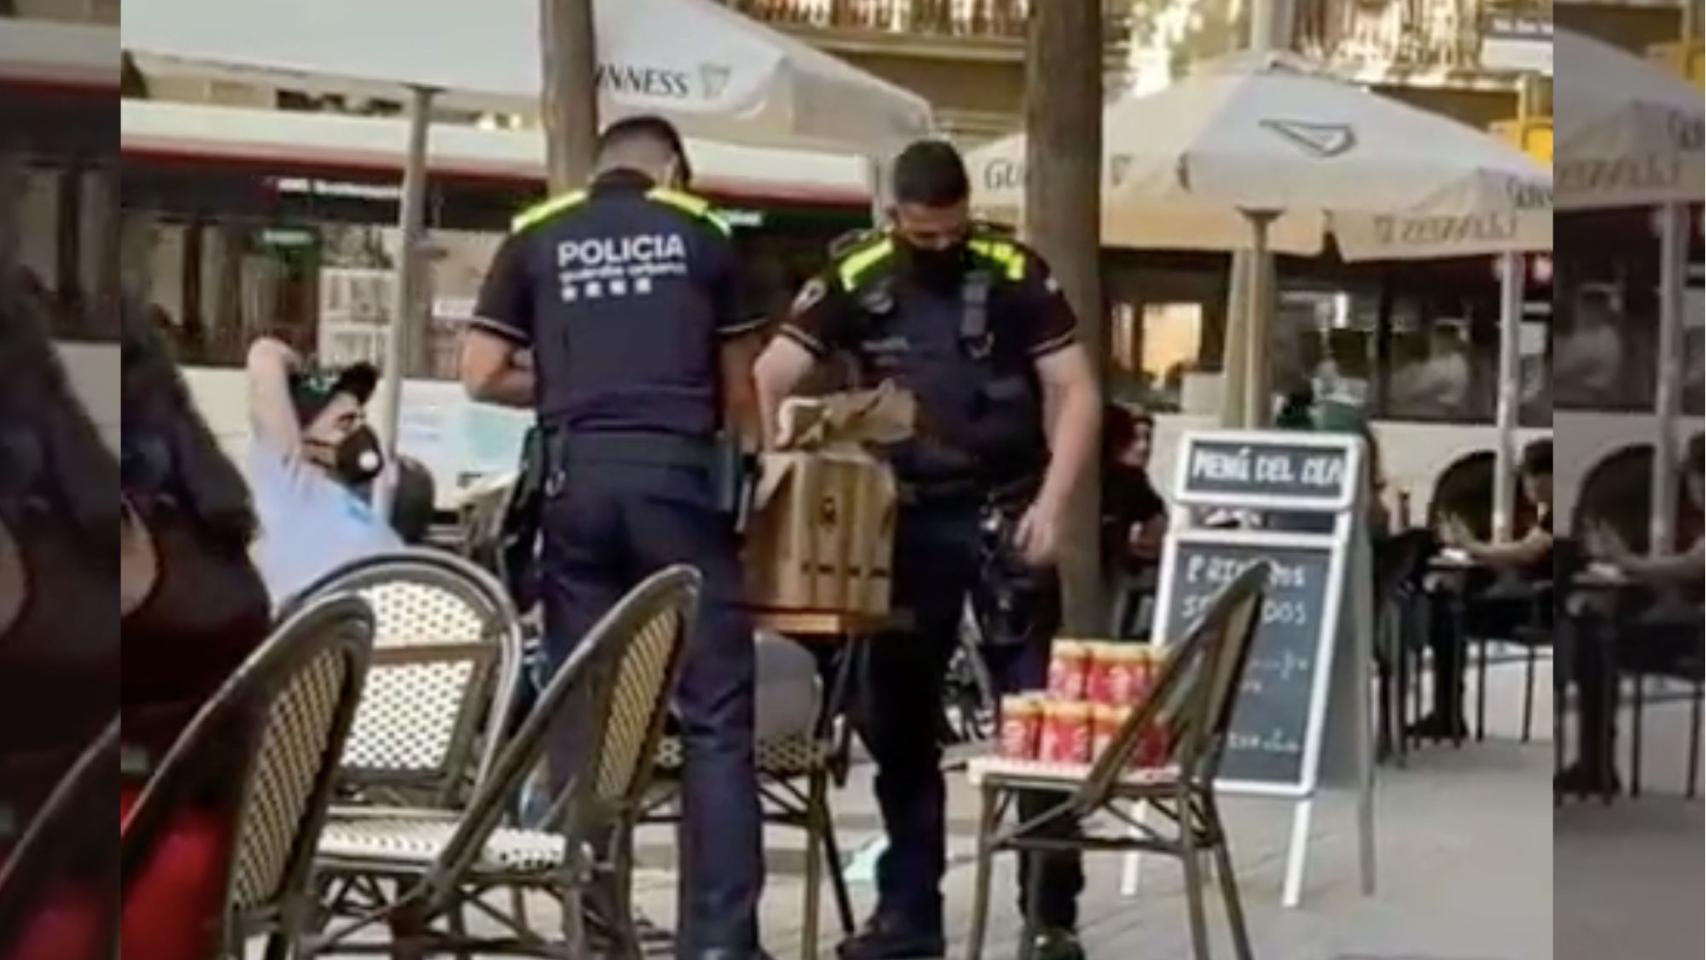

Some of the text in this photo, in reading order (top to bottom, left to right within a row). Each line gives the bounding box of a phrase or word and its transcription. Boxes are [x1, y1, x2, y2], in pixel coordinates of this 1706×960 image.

[594, 62, 689, 99] INNESS
[557, 233, 687, 268] POLICIA
[1254, 455, 1296, 483] DEL
